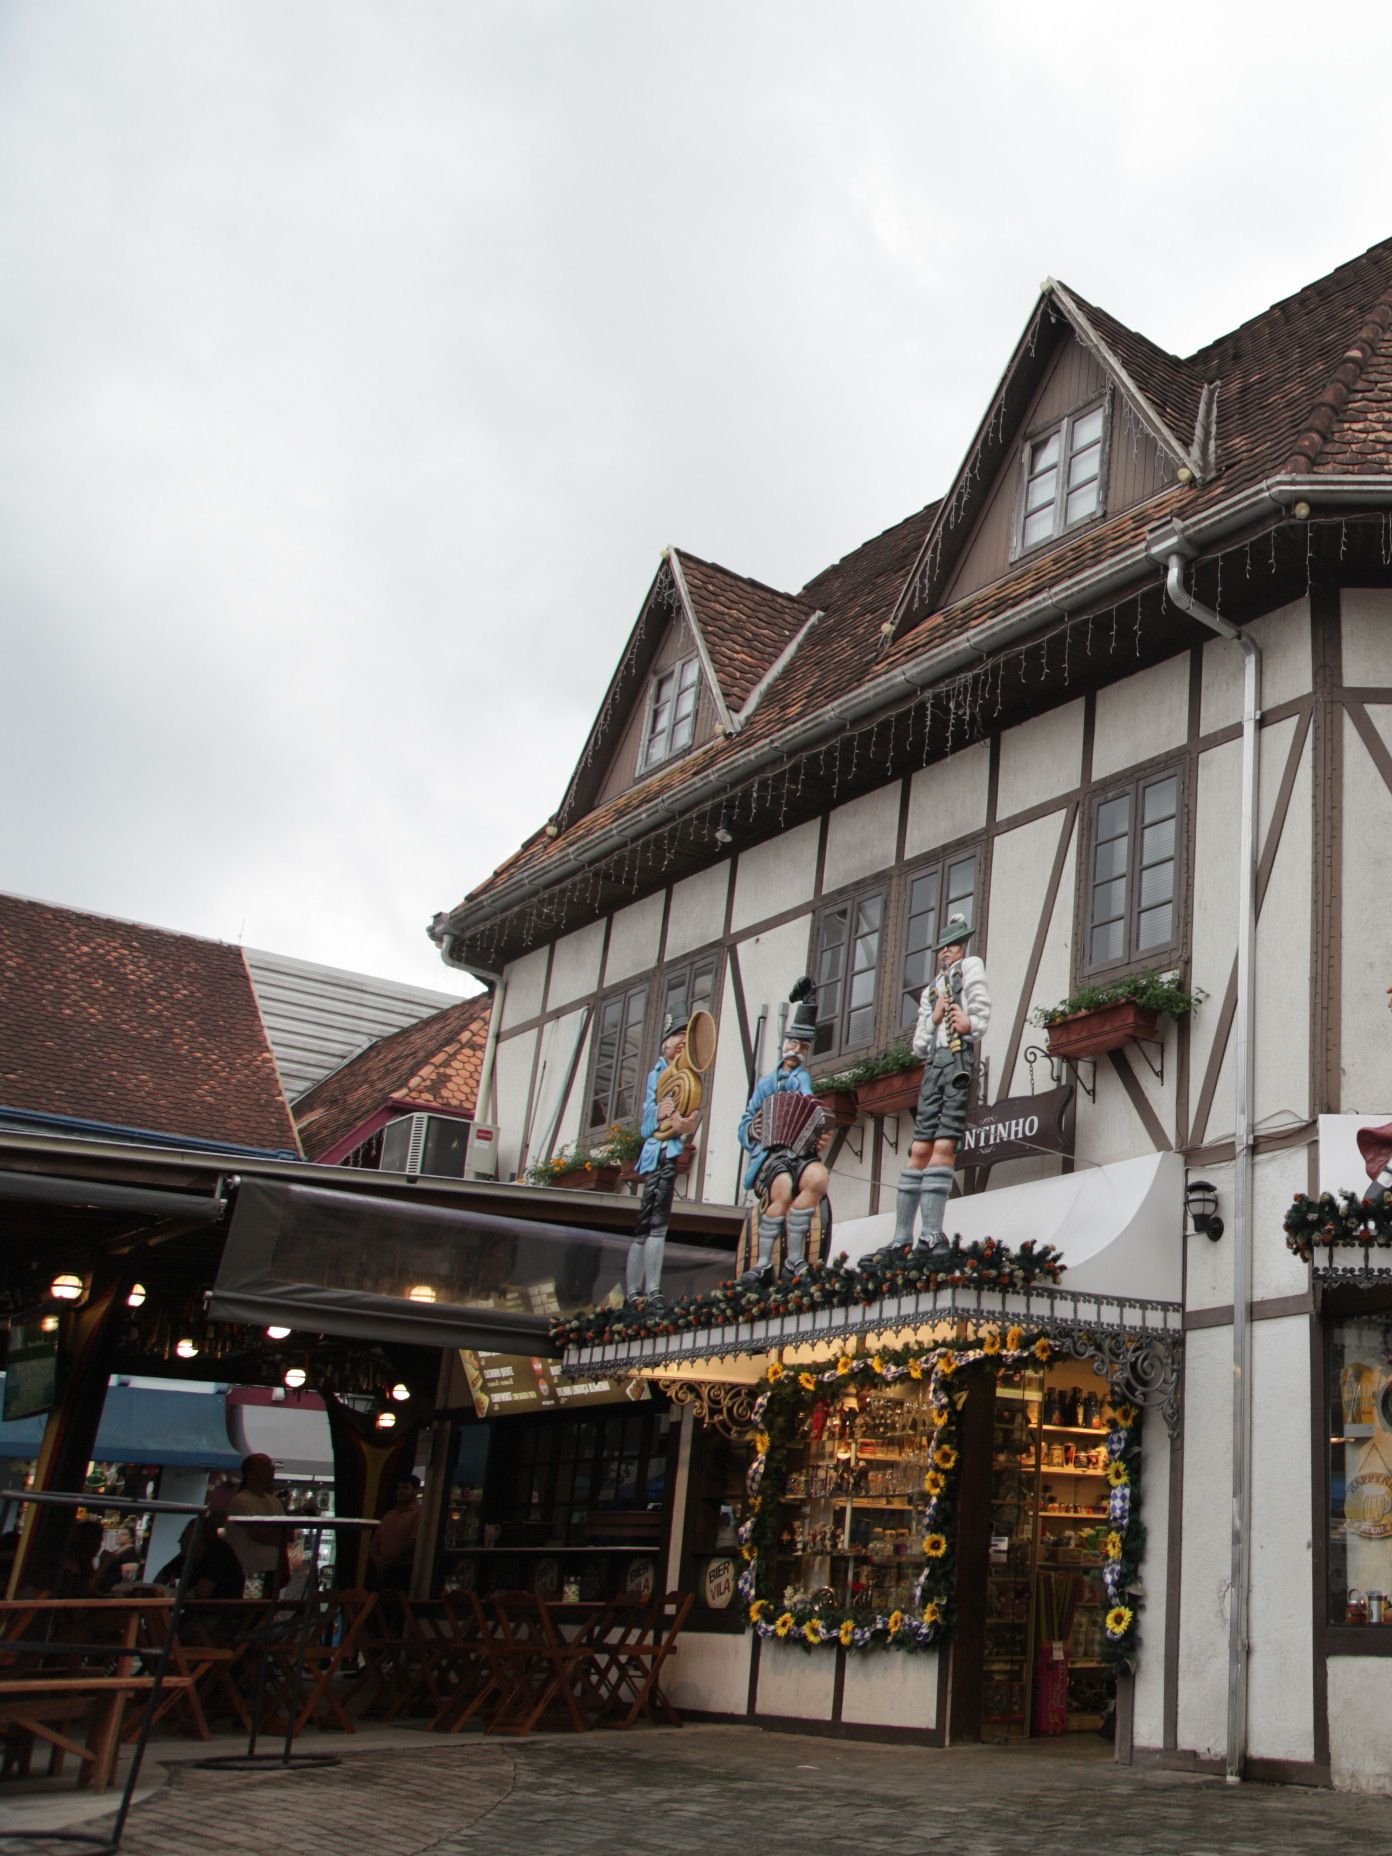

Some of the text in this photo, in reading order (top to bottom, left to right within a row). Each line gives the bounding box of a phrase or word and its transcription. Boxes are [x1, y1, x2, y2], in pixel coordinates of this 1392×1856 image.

[963, 1115, 1039, 1151] NTINHO
[1347, 1473, 1381, 1494] HAPPY
[709, 1560, 730, 1584] BIER
[710, 1578, 730, 1601] VILA
